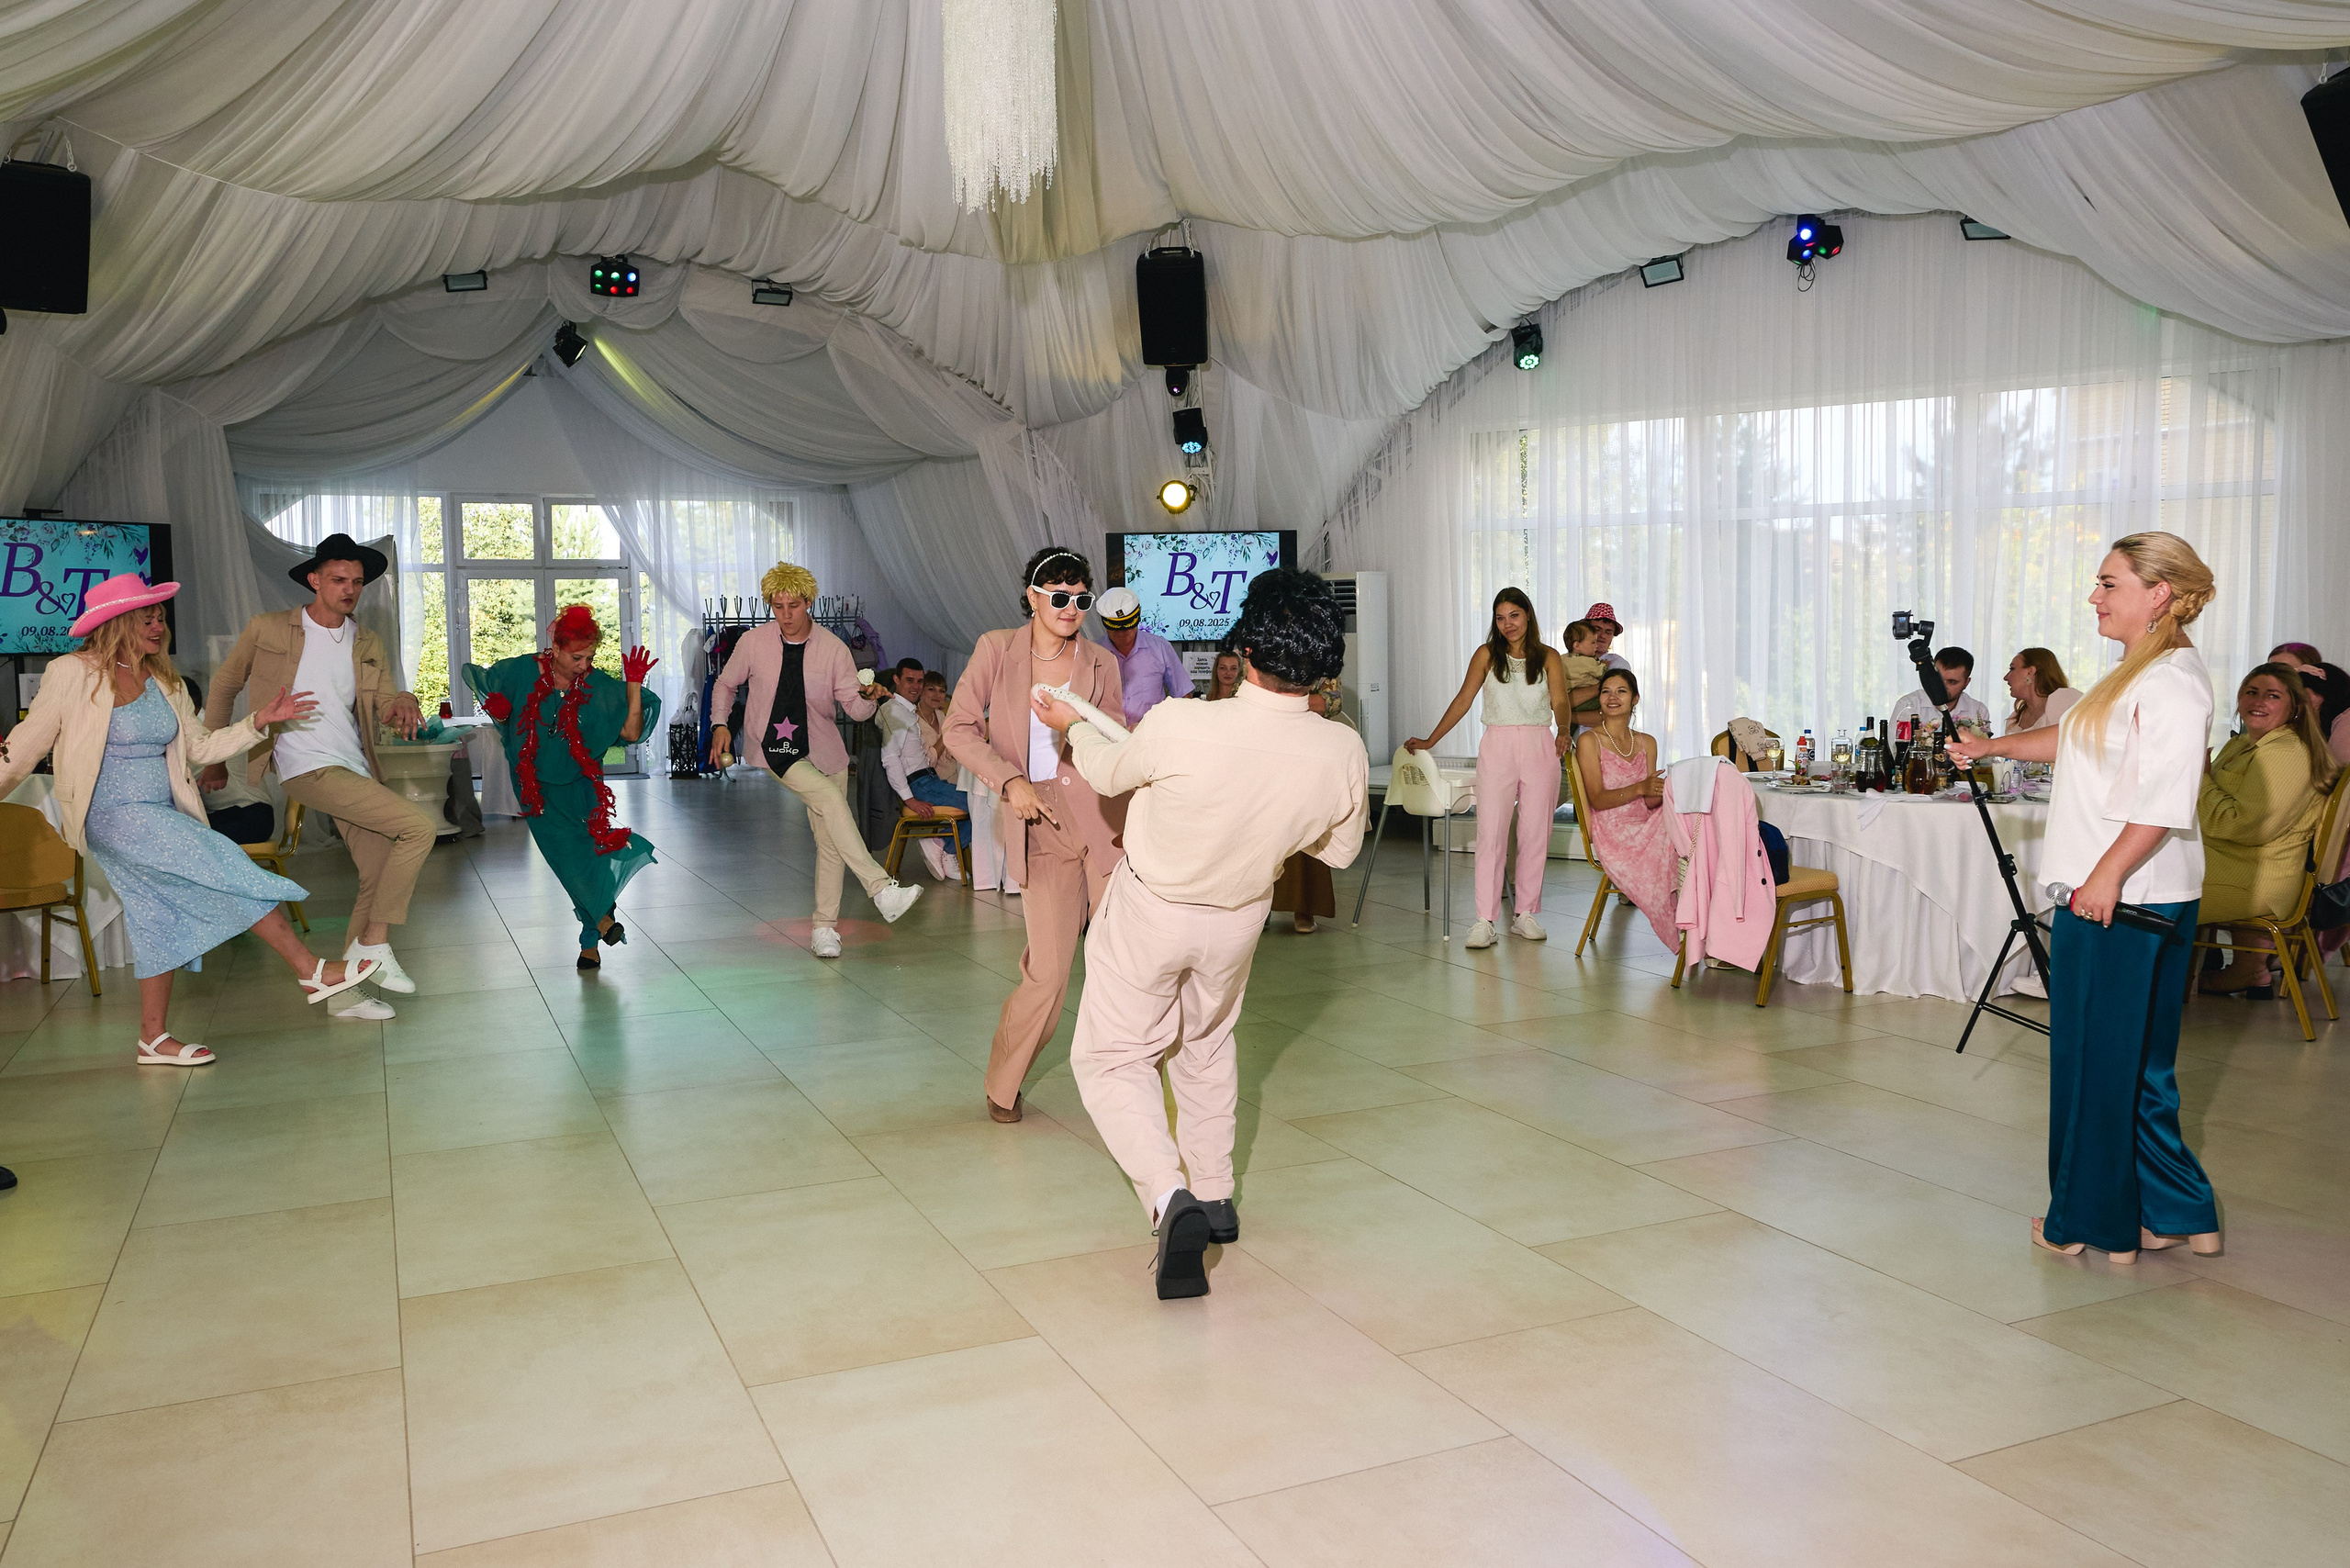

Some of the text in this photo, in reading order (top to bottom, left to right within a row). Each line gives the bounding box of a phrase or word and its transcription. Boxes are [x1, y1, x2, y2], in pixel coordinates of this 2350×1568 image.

[0, 543, 110, 622] B&T
[1160, 552, 1248, 614] B&T
[1179, 618, 1230, 628] 09.08.2025
[21, 626, 73, 636] 09.08.2
[783, 741, 790, 749] В
